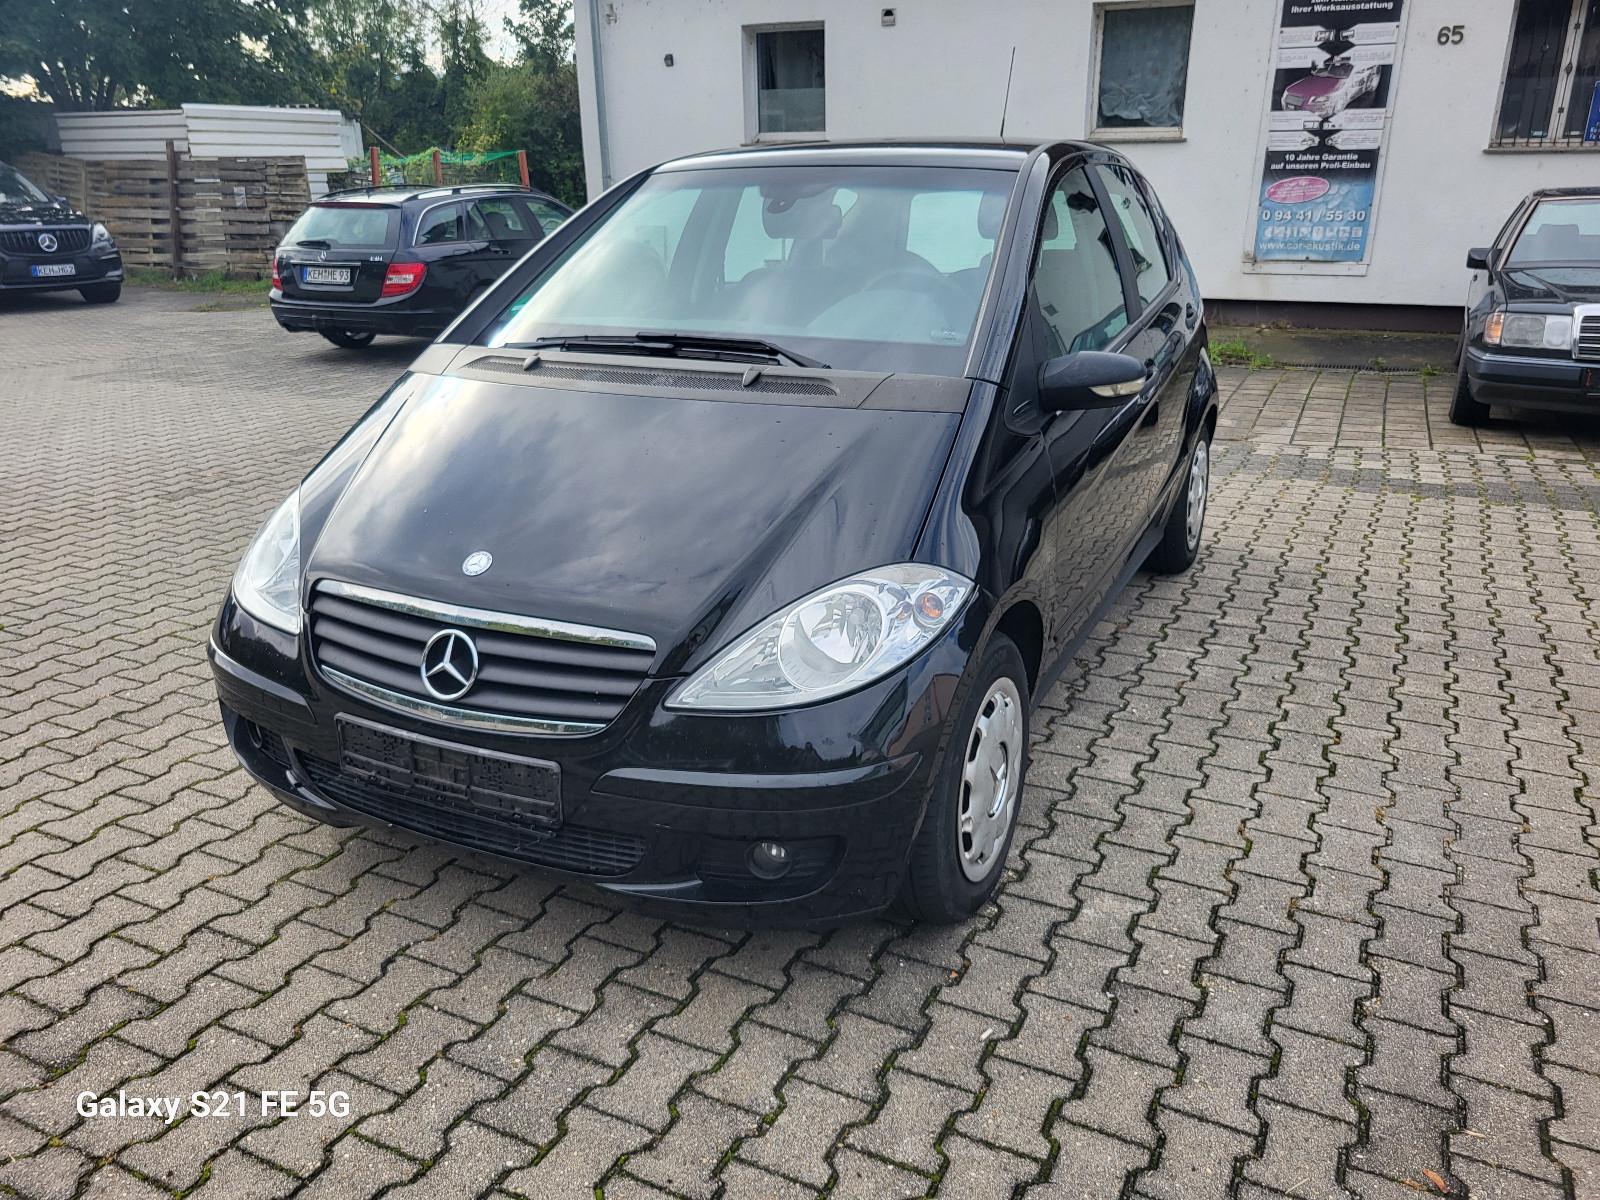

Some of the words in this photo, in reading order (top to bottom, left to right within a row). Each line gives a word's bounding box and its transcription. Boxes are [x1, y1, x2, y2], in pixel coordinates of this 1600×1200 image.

[1291, 6, 1312, 14] Ihrer
[1314, 2, 1393, 12] Werksausstattung
[1437, 25, 1465, 45] 65
[1322, 153, 1358, 161] Garantie
[1270, 162, 1284, 170] auf
[1320, 162, 1371, 170] Profi-Einbau
[1262, 210, 1271, 221] 0
[1274, 210, 1292, 221] 94
[1296, 210, 1313, 221] 41
[1325, 210, 1344, 221] 55
[1347, 210, 1366, 221] 30
[308, 269, 323, 280] KEH
[339, 270, 349, 280] 93
